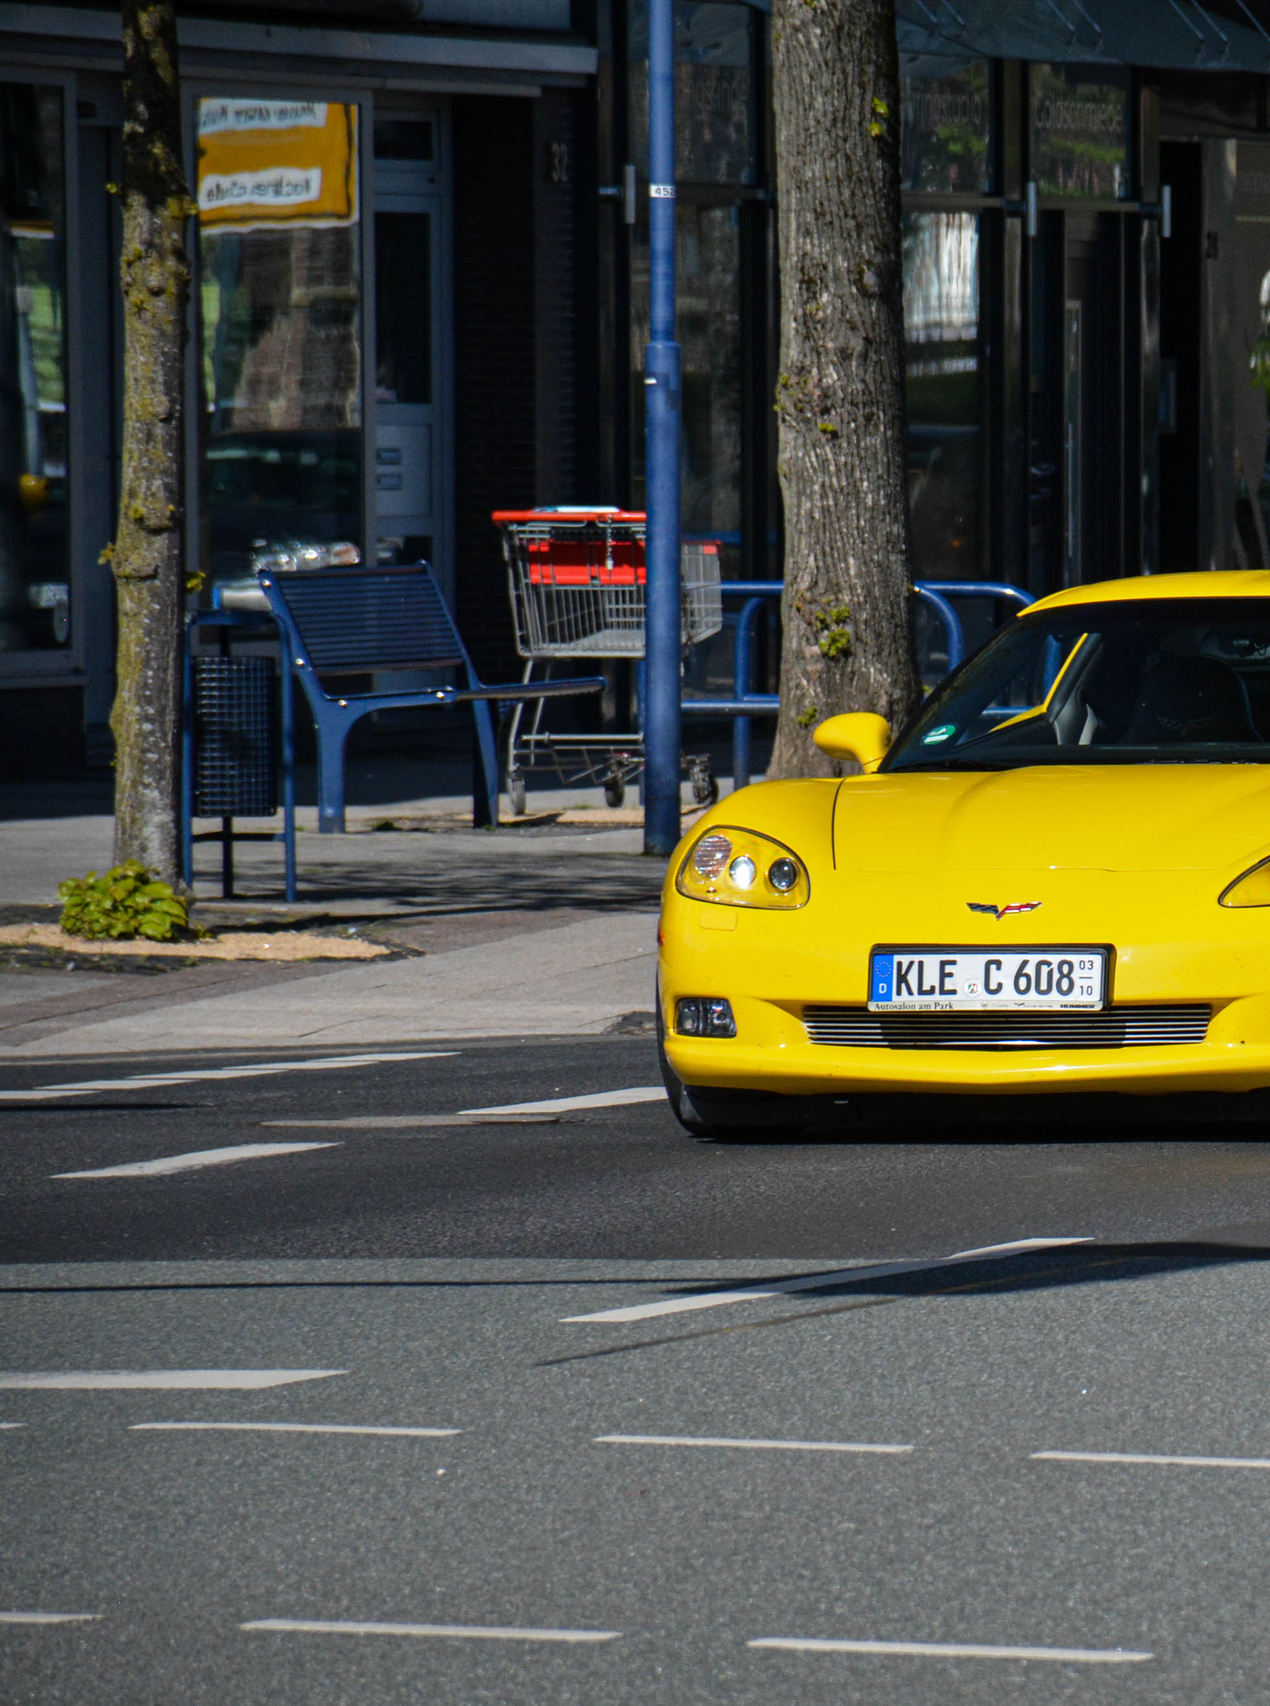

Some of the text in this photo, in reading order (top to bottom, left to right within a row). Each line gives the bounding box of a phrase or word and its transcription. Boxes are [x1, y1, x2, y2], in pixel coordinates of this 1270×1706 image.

[1079, 959, 1095, 971] 03
[895, 958, 1075, 997] KLE C 608
[878, 983, 888, 995] D
[1079, 984, 1094, 997] 10
[874, 1002, 915, 1011] Autosalon
[934, 1001, 954, 1010] Park
